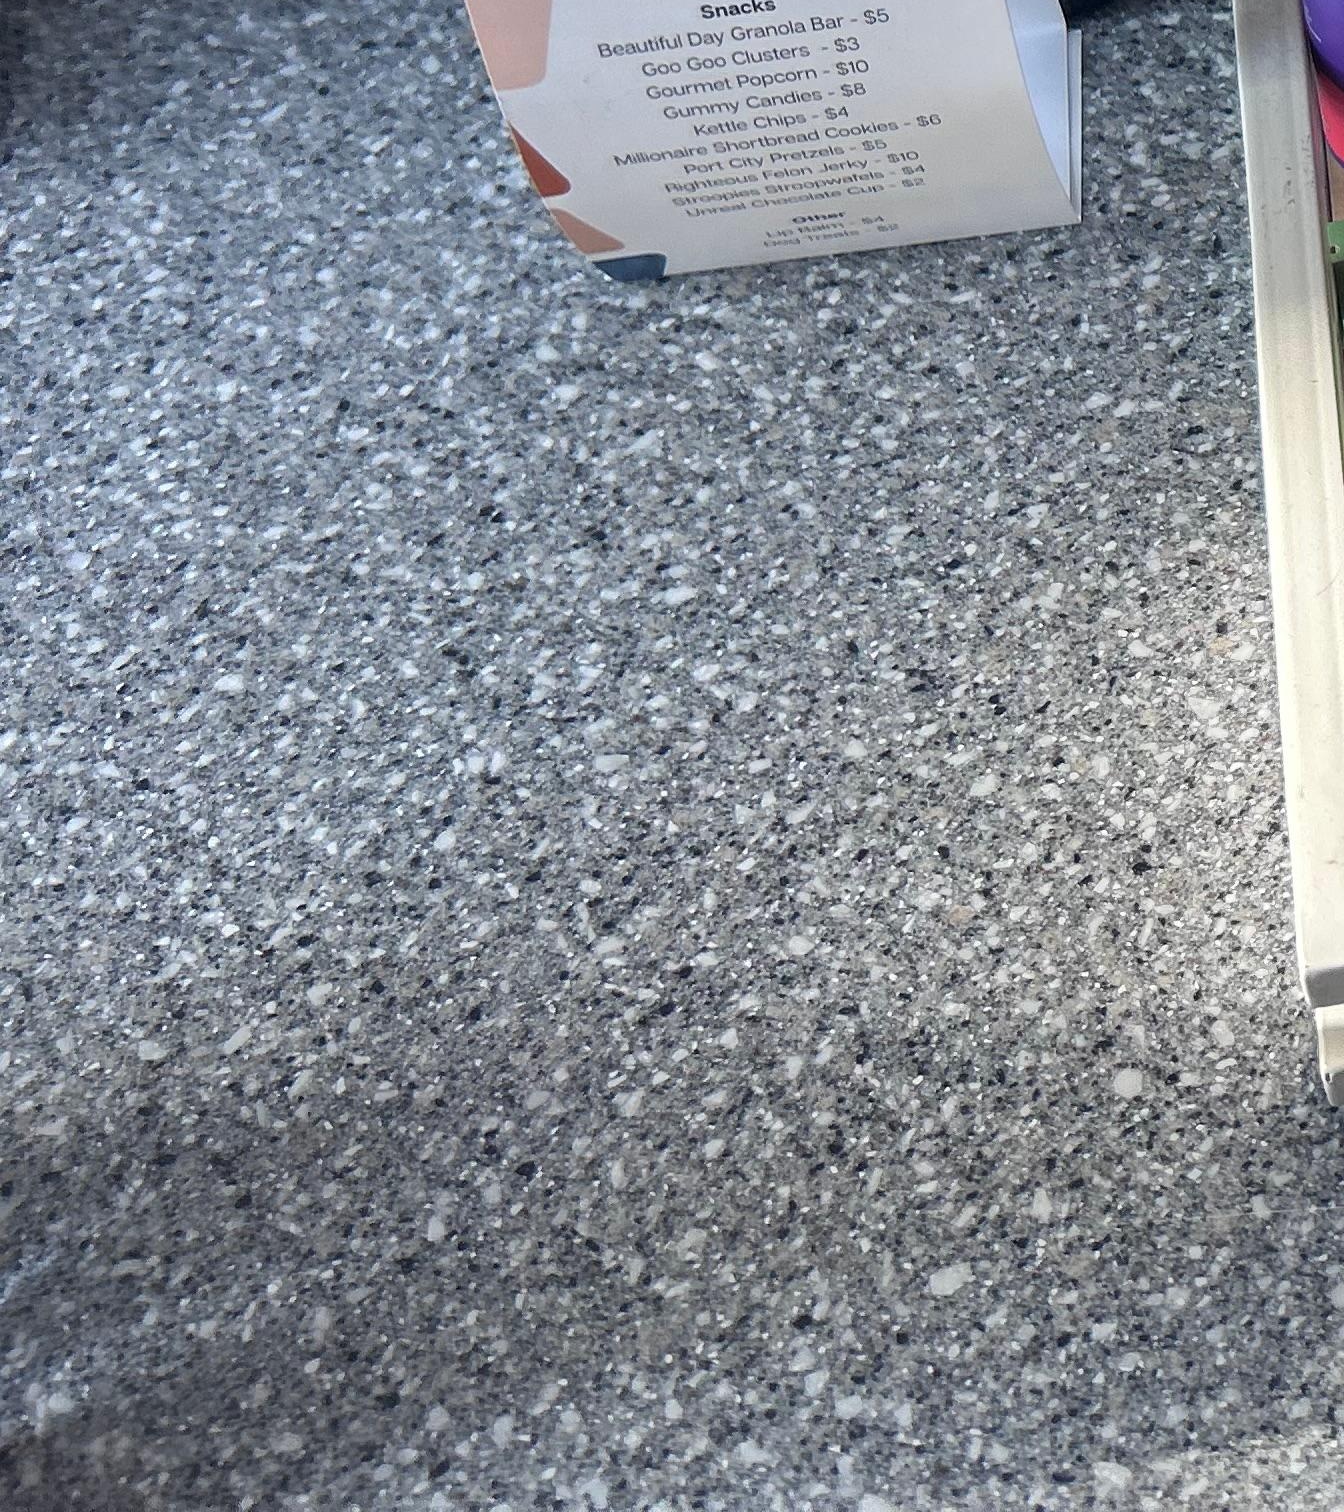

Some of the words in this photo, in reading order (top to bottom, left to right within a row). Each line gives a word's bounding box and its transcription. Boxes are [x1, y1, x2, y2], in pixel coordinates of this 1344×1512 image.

[598, 33, 683, 59] Beautiful
[687, 30, 725, 48] Day
[731, 21, 806, 41] Granola
[811, 15, 845, 32] Bar
[863, 7, 890, 26] $5
[642, 61, 682, 77] Goo
[687, 55, 727, 71] Goo
[732, 44, 811, 66] Clusters
[834, 36, 860, 54] $3
[646, 77, 732, 101] Gourmet
[736, 67, 818, 89] Popcorn
[836, 59, 869, 76] $10
[664, 99, 740, 120] Gummy
[746, 88, 823, 110] Candies
[840, 82, 867, 99] $8
[613, 144, 709, 168] Millionaire
[713, 128, 820, 154] Shortbread
[825, 119, 900, 140] Cookies
[916, 114, 943, 129] $6
[693, 119, 749, 138] Kettle
[753, 111, 808, 130] Chips
[824, 106, 850, 122] $4
[684, 161, 724, 175] Port
[729, 156, 764, 170] City
[770, 145, 845, 164] Pretzels
[820, 158, 868, 175] Jerky
